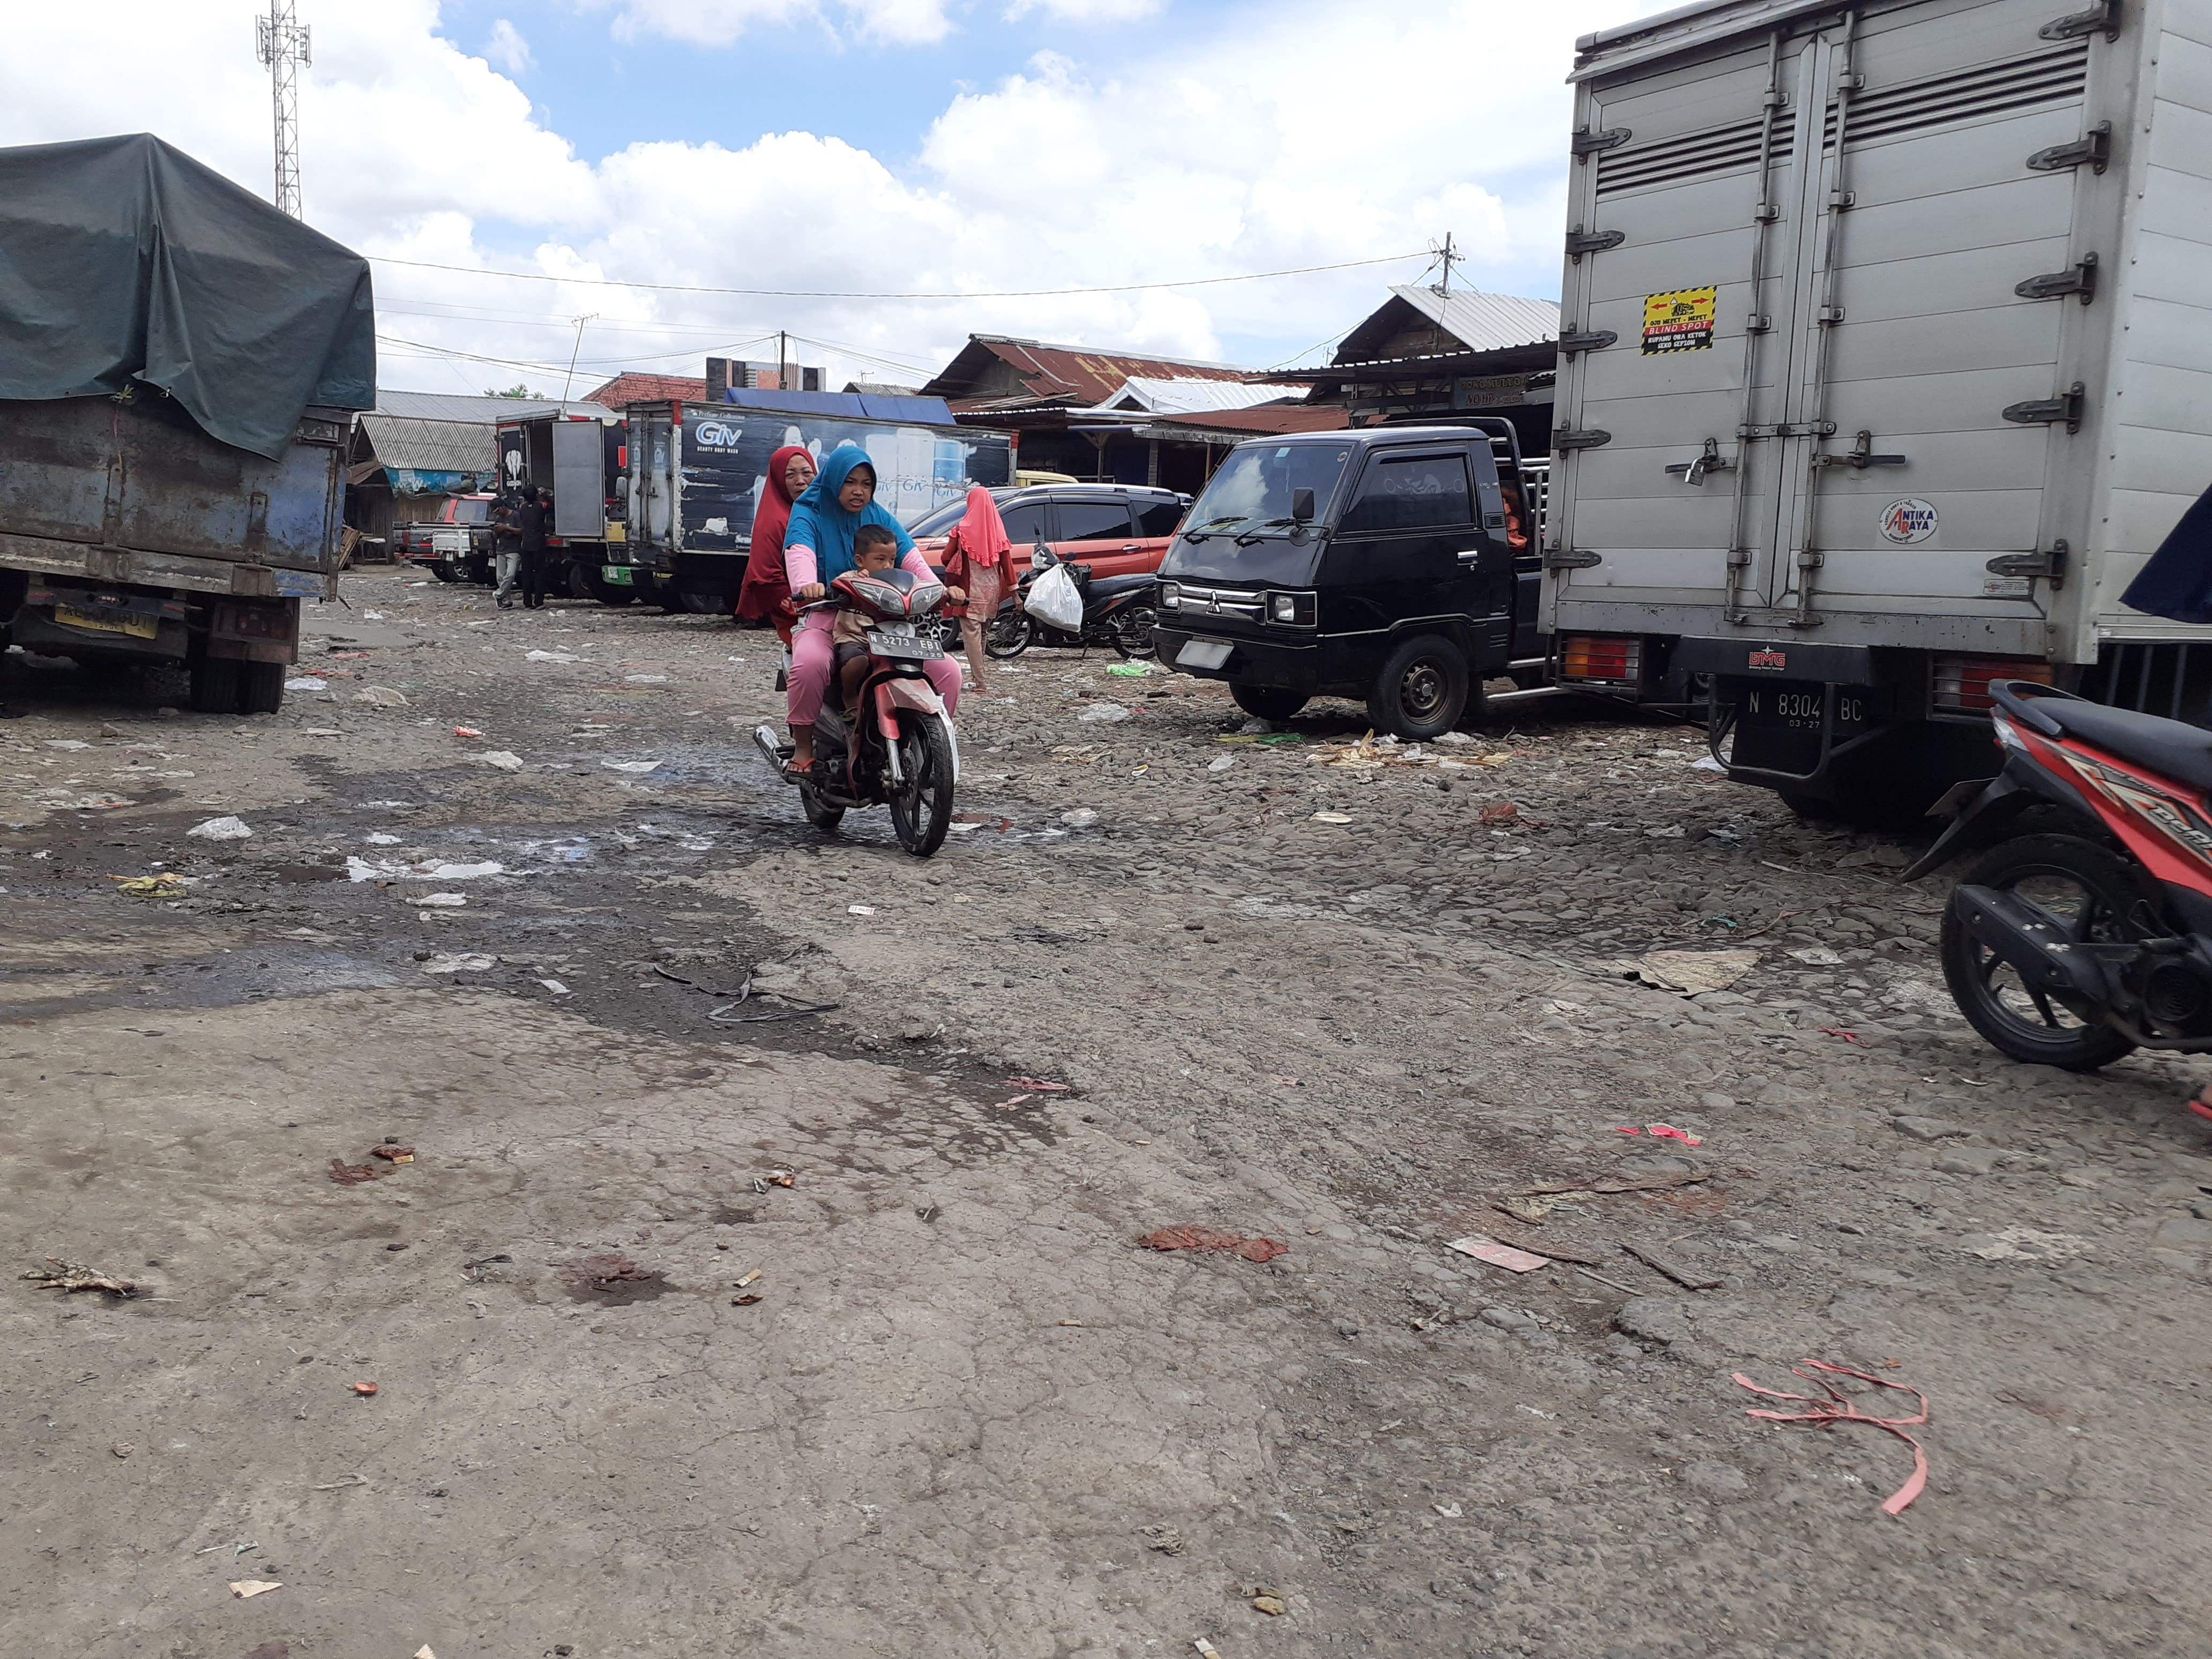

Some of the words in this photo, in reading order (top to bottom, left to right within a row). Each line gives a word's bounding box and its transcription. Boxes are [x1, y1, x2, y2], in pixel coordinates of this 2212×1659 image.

[1649, 325, 1678, 334] BLIND
[1682, 321, 1708, 331] SPOT
[1648, 335, 1671, 343] RUPAMU
[696, 421, 742, 446] Giv
[1886, 509, 1933, 530] ANTIKA
[1901, 520, 1929, 534] RAYA
[881, 636, 910, 647] 5273
[1749, 652, 1785, 666] BMG
[1749, 692, 1759, 713] N
[1778, 694, 1821, 718] 8304
[1841, 697, 1862, 721] BC
